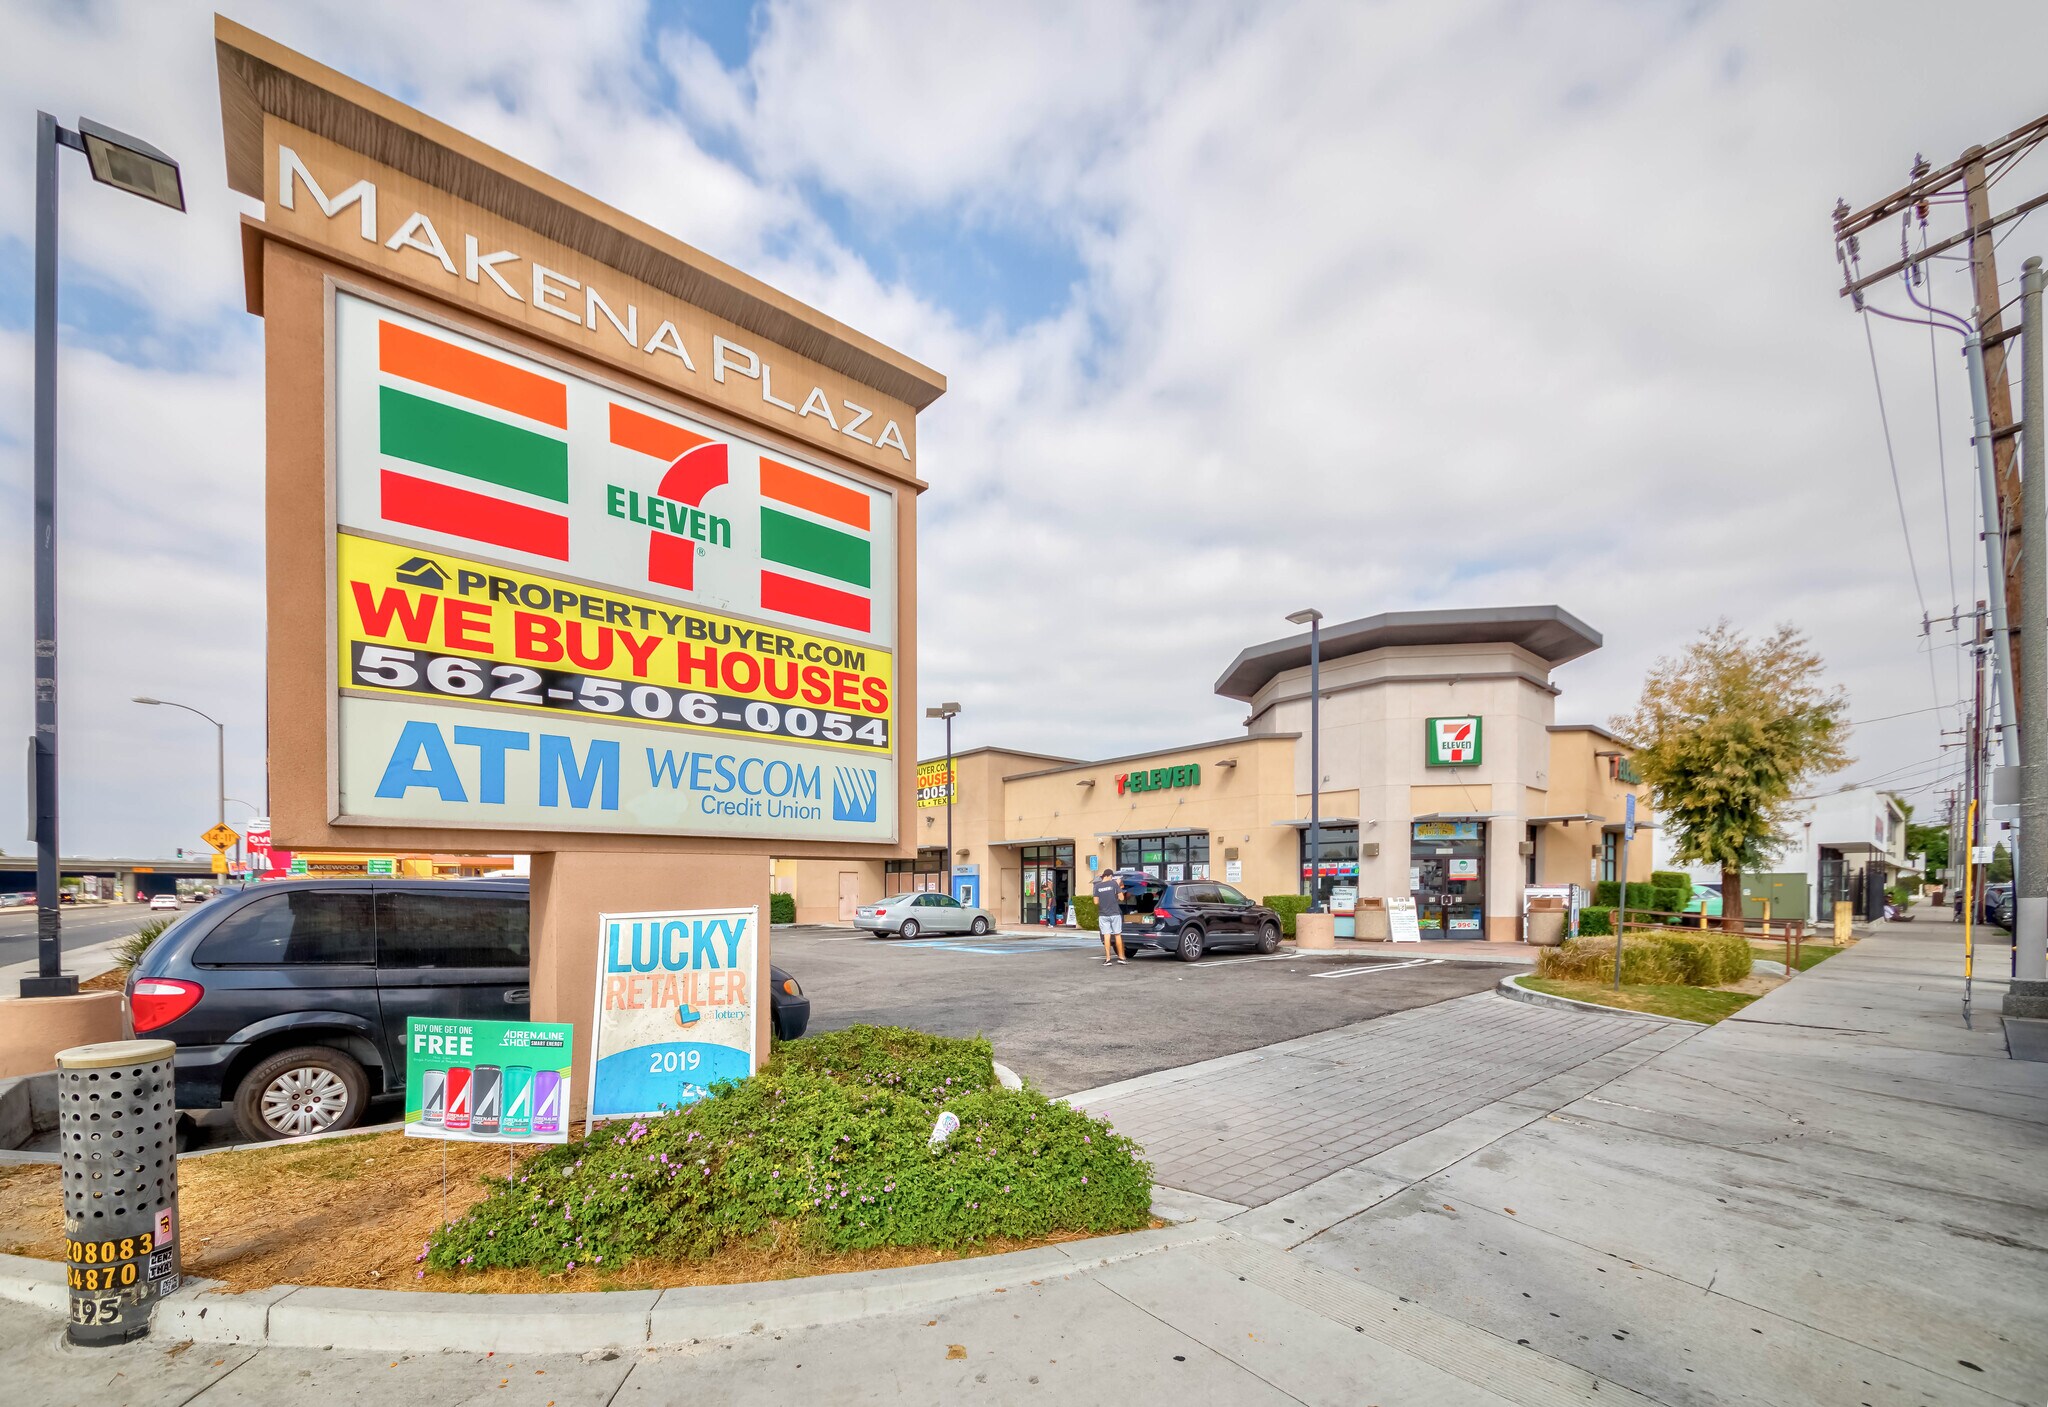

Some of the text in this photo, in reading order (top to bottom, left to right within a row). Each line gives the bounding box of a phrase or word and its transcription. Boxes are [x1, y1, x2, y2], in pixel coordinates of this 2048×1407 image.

[279, 144, 912, 461] MAKENA PLAZA
[458, 569, 866, 672] PROPERTYBUYER.COM
[350, 580, 889, 714] WE BUY HOUSES
[356, 645, 887, 746] 562-506-0054
[374, 720, 821, 811] ATM WESCOM
[917, 770, 955, 788] OUSES
[701, 795, 821, 820] Credit Union
[607, 919, 747, 973] LUCKY
[605, 970, 747, 1011] RETAILER
[414, 1023, 473, 1035] BUY ONE GET ONE
[414, 1034, 474, 1057] FREE
[503, 1029, 565, 1040] ADRENALINE
[650, 1050, 701, 1074] 2019
